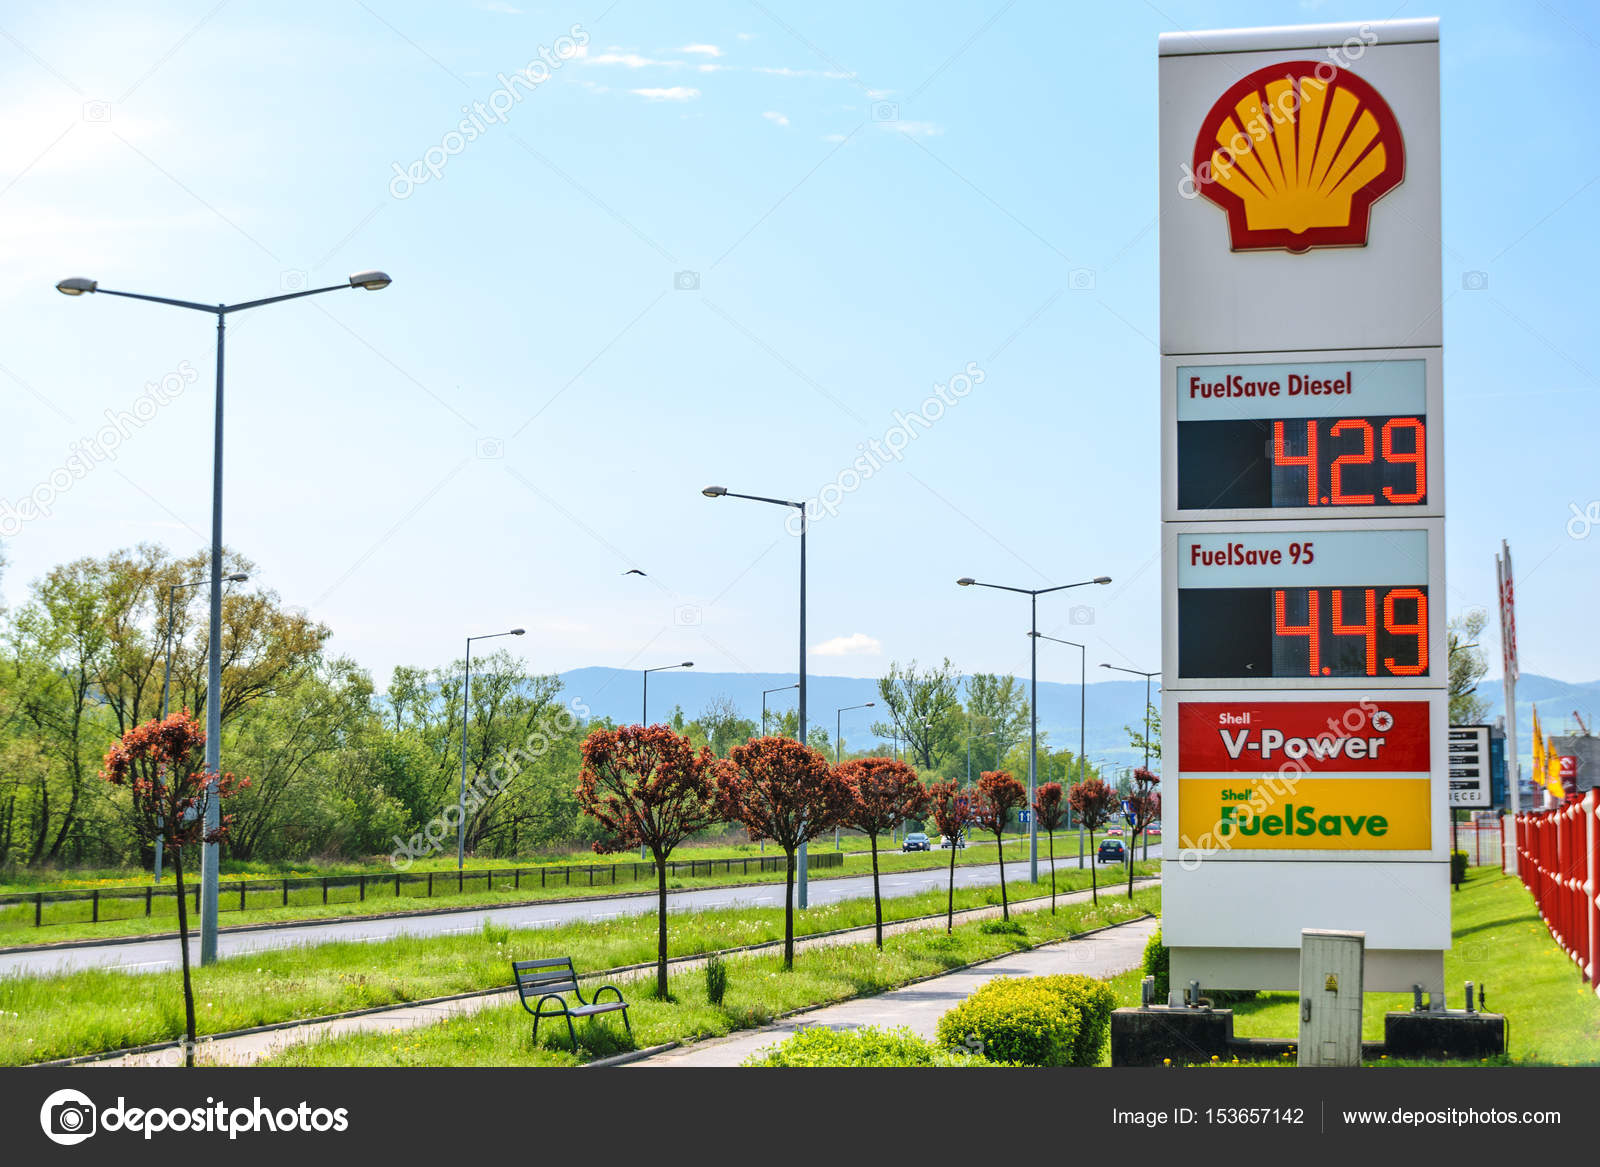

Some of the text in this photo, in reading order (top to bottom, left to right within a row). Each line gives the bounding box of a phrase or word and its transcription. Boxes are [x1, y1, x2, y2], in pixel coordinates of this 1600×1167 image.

[1190, 371, 1352, 398] FuelSave Diesel
[1274, 417, 1426, 506] 4.29
[1190, 543, 1315, 566] FuelSave 95
[1275, 588, 1428, 676] 4.49
[1219, 712, 1250, 725] Shell
[1218, 728, 1386, 759] V-Power
[1221, 789, 1252, 801] Shell
[1221, 803, 1389, 837] FuelSave
